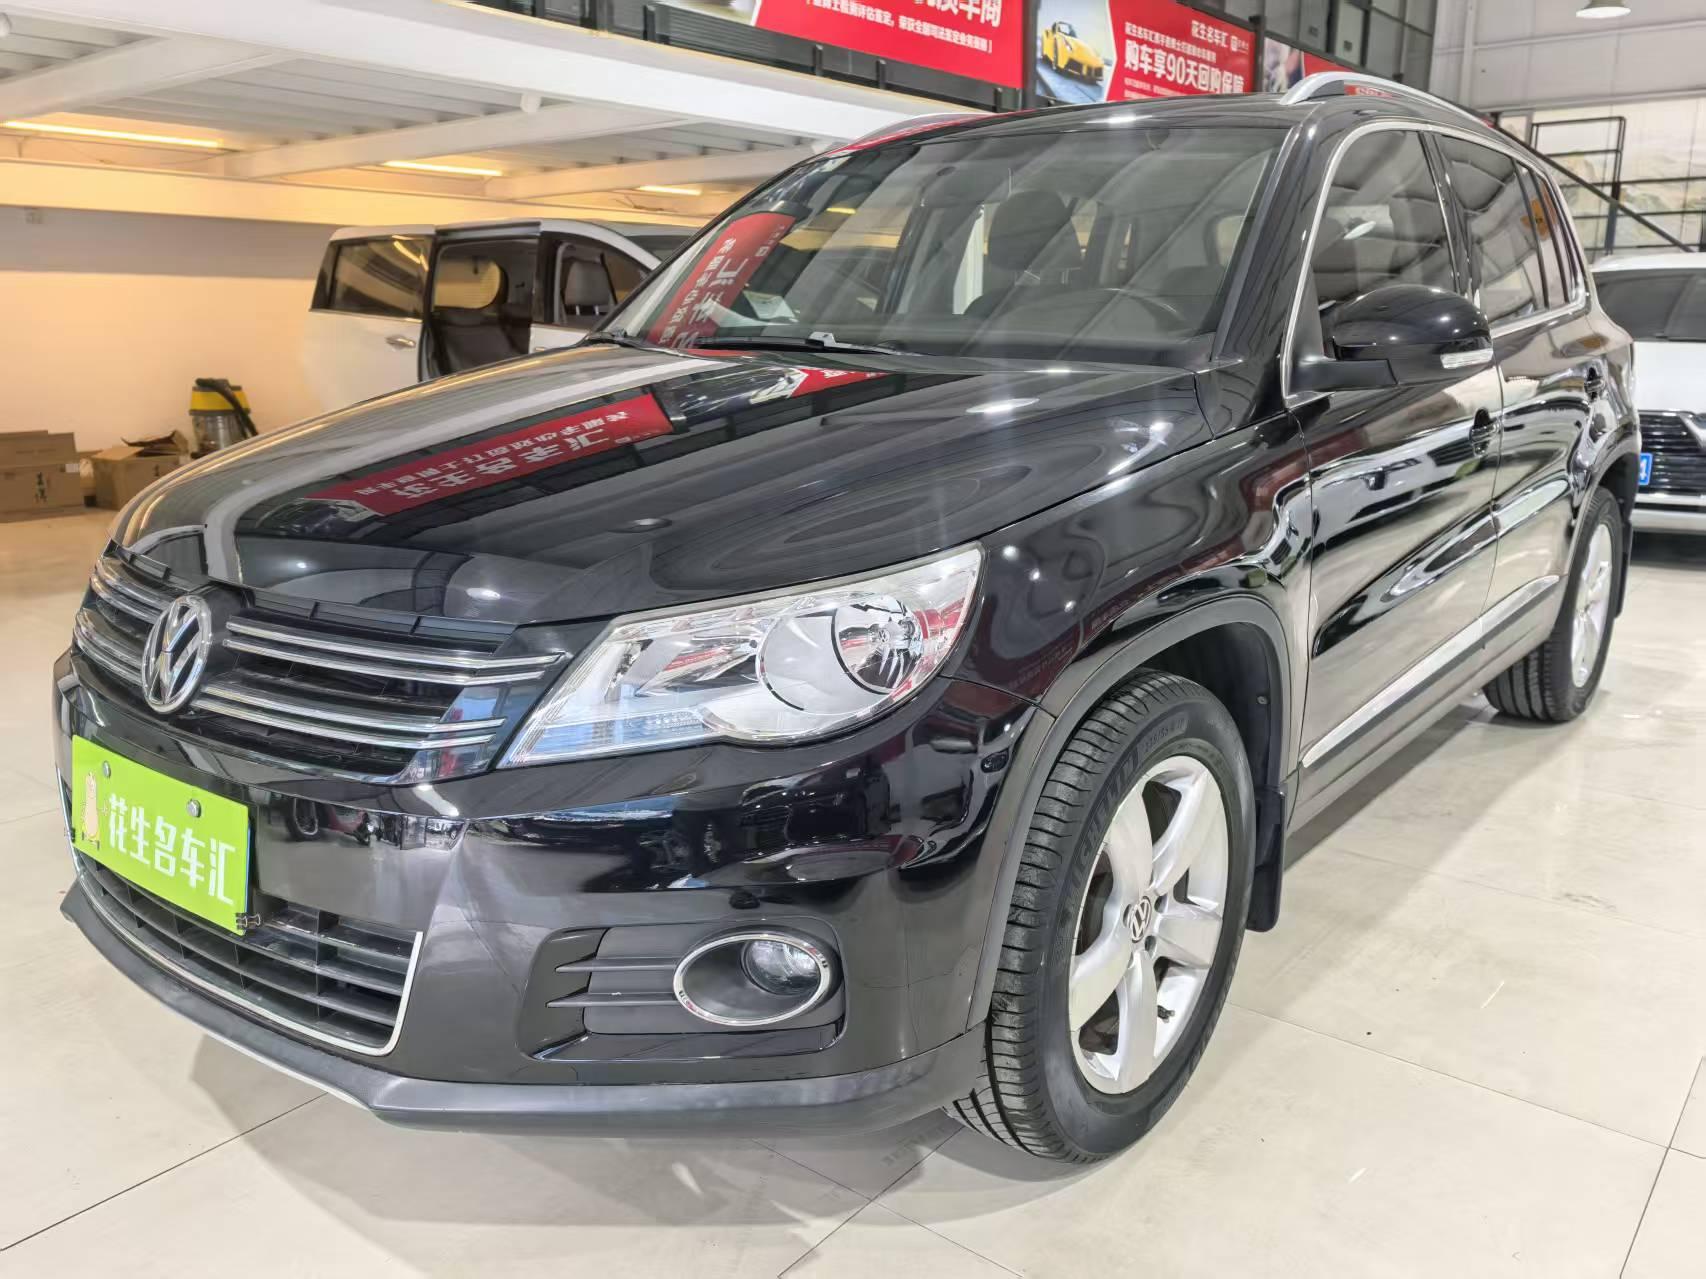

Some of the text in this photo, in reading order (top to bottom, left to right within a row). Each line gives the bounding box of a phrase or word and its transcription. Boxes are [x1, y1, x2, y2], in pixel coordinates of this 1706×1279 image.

[109, 793, 236, 905] 花生名车汇
